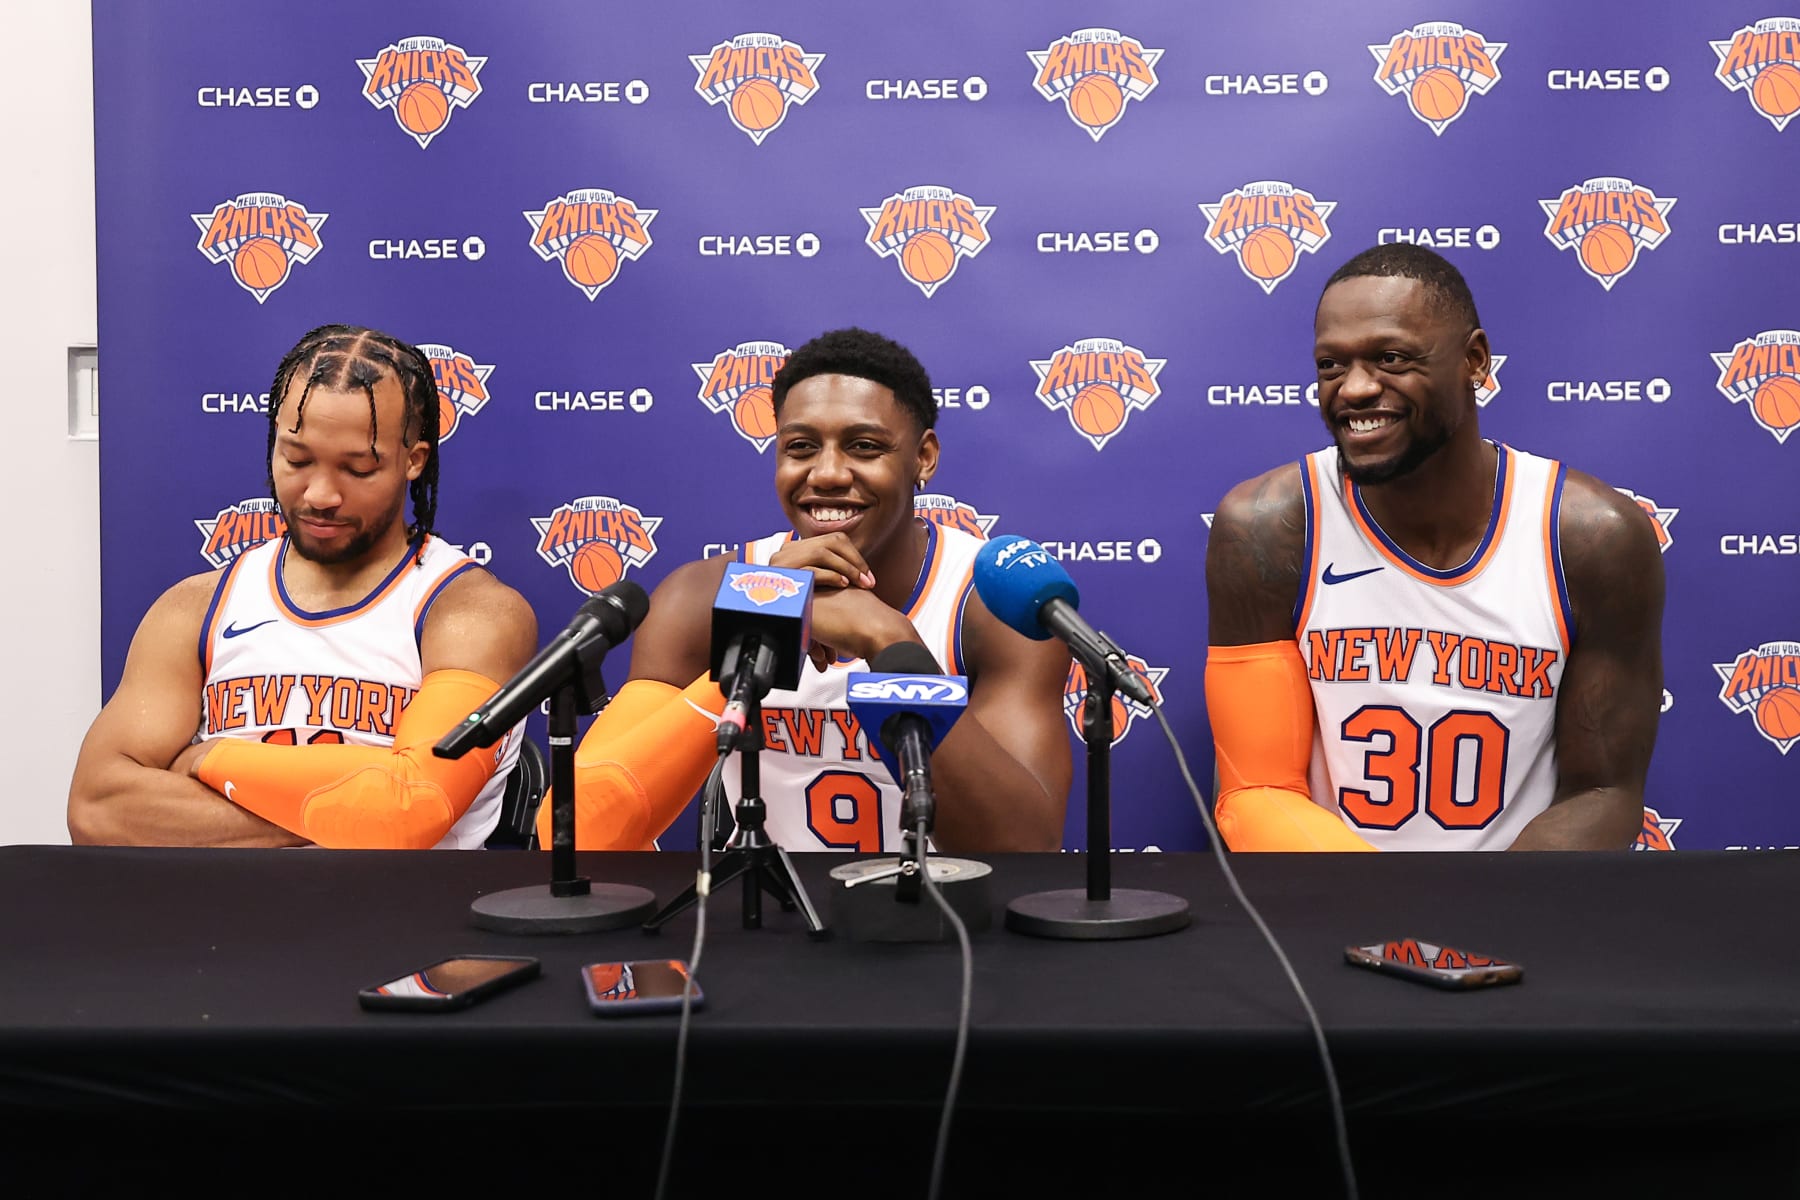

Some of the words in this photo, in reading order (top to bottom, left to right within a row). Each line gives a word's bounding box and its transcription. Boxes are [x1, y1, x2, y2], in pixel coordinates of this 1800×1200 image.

[368, 49, 477, 94] KNICKS
[701, 46, 816, 91] KNICKS
[1039, 41, 1154, 86] KNICKS
[1379, 34, 1496, 80] KNICKS
[1720, 31, 1800, 76] KNIC
[198, 87, 291, 107] CHASE
[528, 83, 620, 103] CHASE
[866, 79, 959, 100] CHASE
[1205, 74, 1299, 95] CHASE
[1547, 69, 1641, 90] CHASE
[203, 205, 318, 250] KNICKS
[535, 201, 648, 246] KNICKS
[872, 198, 987, 243] KNICKS
[1210, 193, 1326, 239] KNICKS
[1550, 189, 1666, 235] KNICKS
[1718, 223, 1800, 244] CHAS
[369, 239, 458, 259] CHASE
[699, 235, 792, 256] CHASE
[1037, 232, 1130, 253] CHASE
[1378, 227, 1471, 248] CHASE
[1041, 350, 1157, 395] KNICKS
[1721, 343, 1800, 388] KNIC
[202, 393, 270, 413] CHAS
[535, 391, 625, 411] CHASE
[1207, 385, 1301, 405] CHASE
[1547, 381, 1642, 401] CHASE
[542, 508, 654, 554] KNICKS
[1720, 534, 1800, 555] CHAS
[1307, 627, 1422, 682] NEW
[1427, 628, 1558, 699] YORK
[1783, 645, 1800, 654] YOR
[848, 681, 951, 701] SNY
[1724, 654, 1800, 699] KNIC
[206, 674, 297, 735] NEW
[760, 707, 826, 756] EW
[1338, 704, 1511, 831] 30
[804, 770, 885, 853] 9
